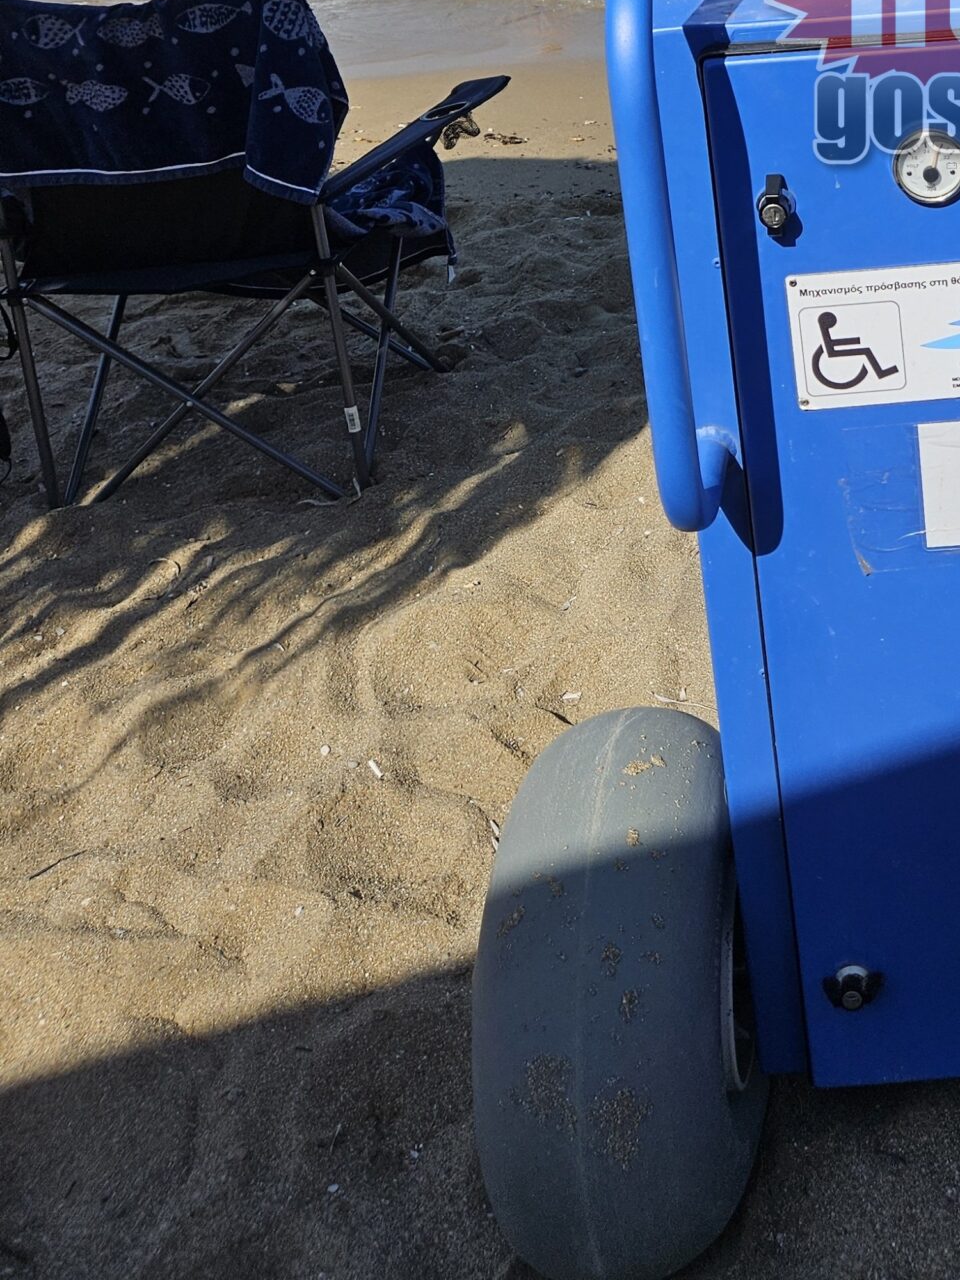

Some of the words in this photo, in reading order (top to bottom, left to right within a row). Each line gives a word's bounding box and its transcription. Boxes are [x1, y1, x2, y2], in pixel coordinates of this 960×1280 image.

[799, 284, 863, 297] Μηχανισμός
[866, 281, 927, 293] πρόσβασης
[929, 279, 948, 287] στη
